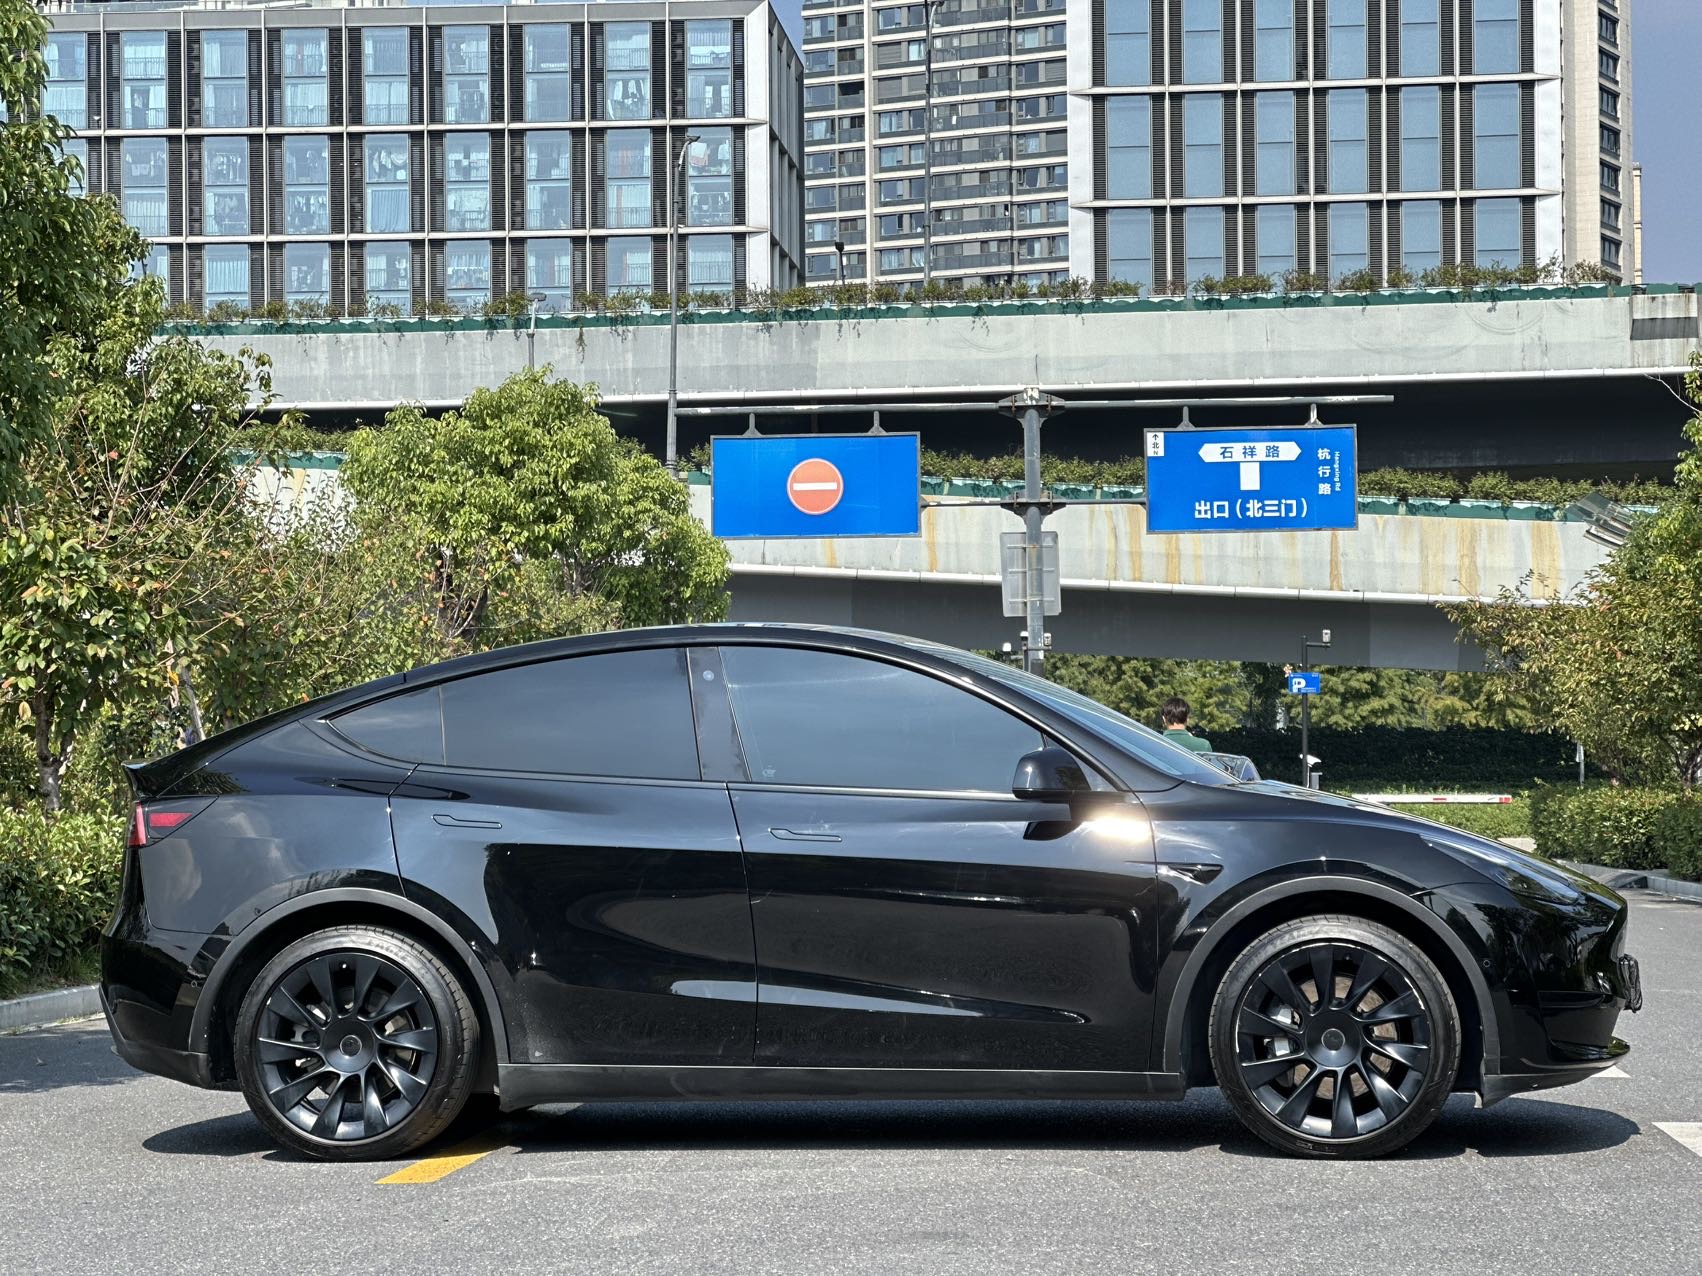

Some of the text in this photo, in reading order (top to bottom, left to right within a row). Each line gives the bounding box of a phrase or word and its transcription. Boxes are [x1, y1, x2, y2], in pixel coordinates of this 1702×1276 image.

[1152, 441, 1160, 449] 北
[1219, 445, 1280, 459] 石祥路
[1317, 447, 1332, 495] 杭行路
[1194, 497, 1308, 519] 出口（北三门）
